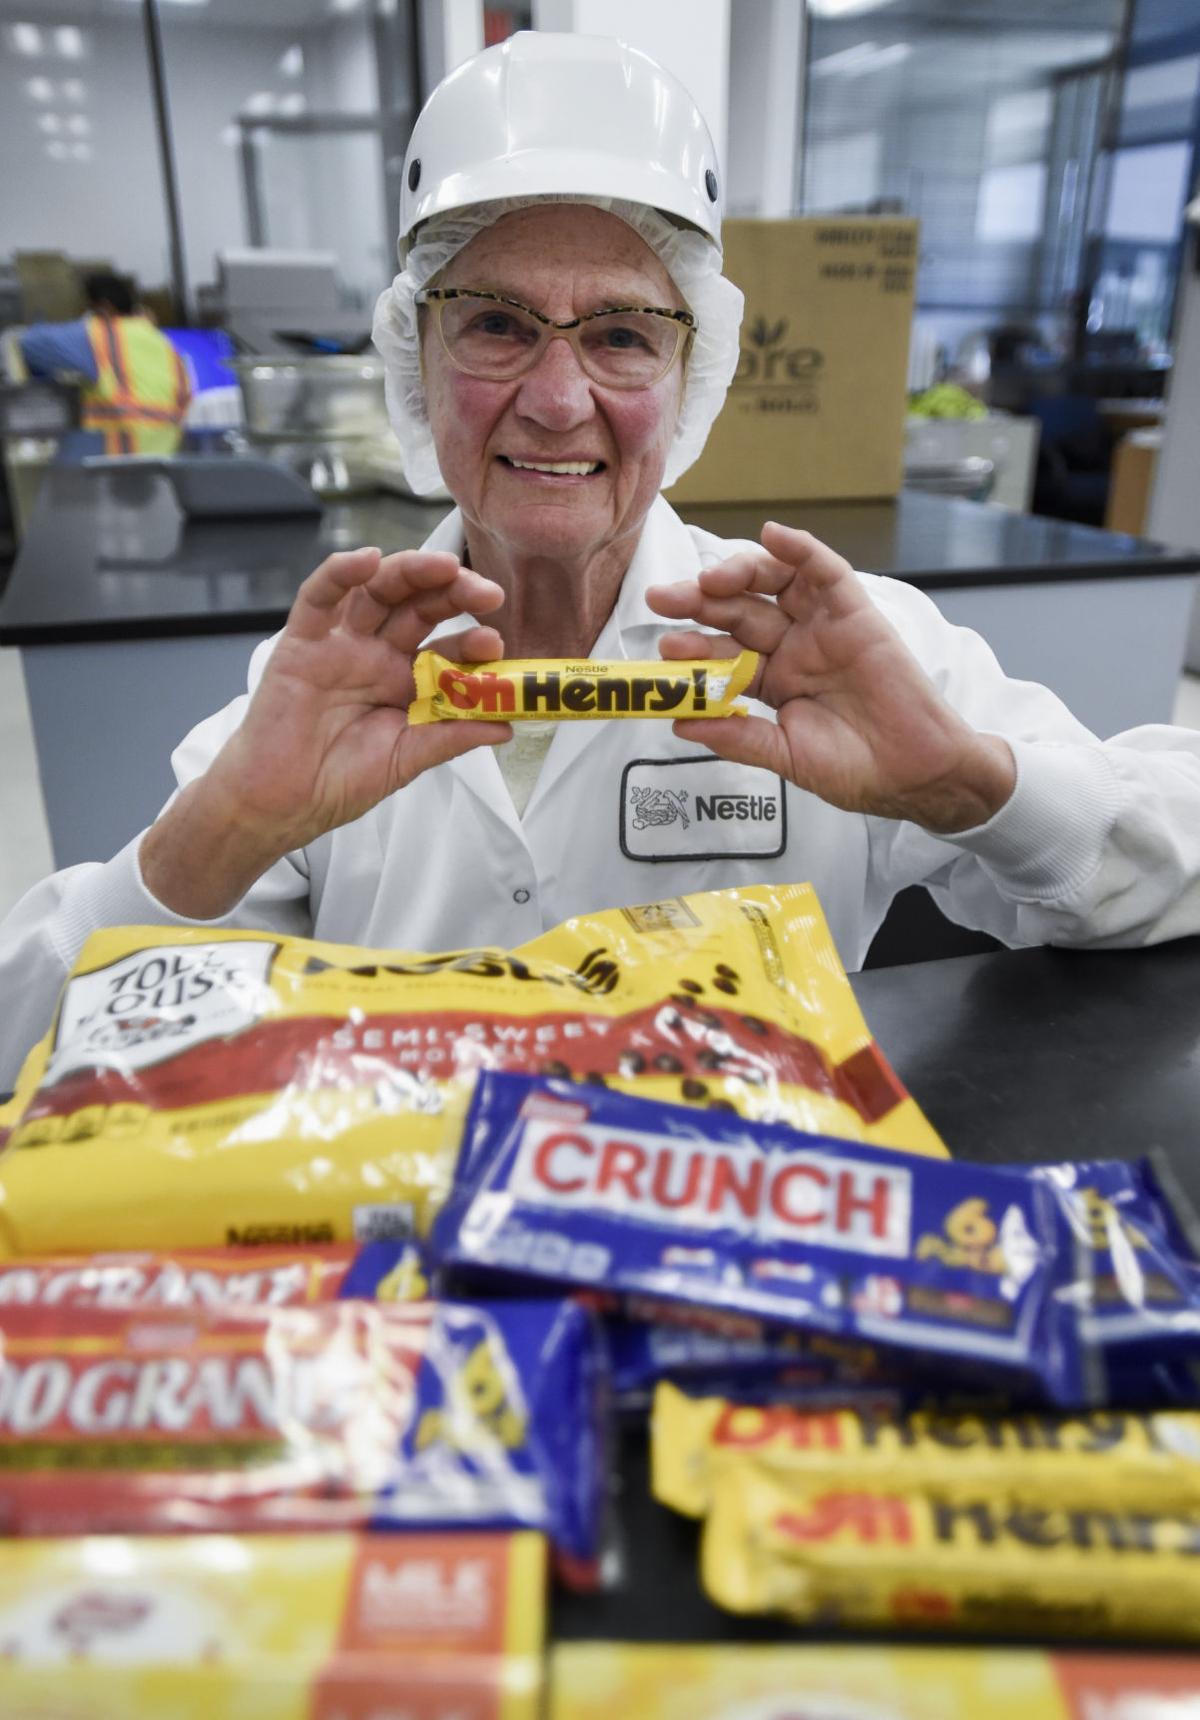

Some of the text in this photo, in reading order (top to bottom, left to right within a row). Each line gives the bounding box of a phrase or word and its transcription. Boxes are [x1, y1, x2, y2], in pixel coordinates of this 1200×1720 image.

[438, 668, 707, 713] Oh Henry!
[695, 795, 777, 822] Nestlé
[533, 1132, 890, 1238] CRUNCH
[945, 1196, 998, 1247] 6
